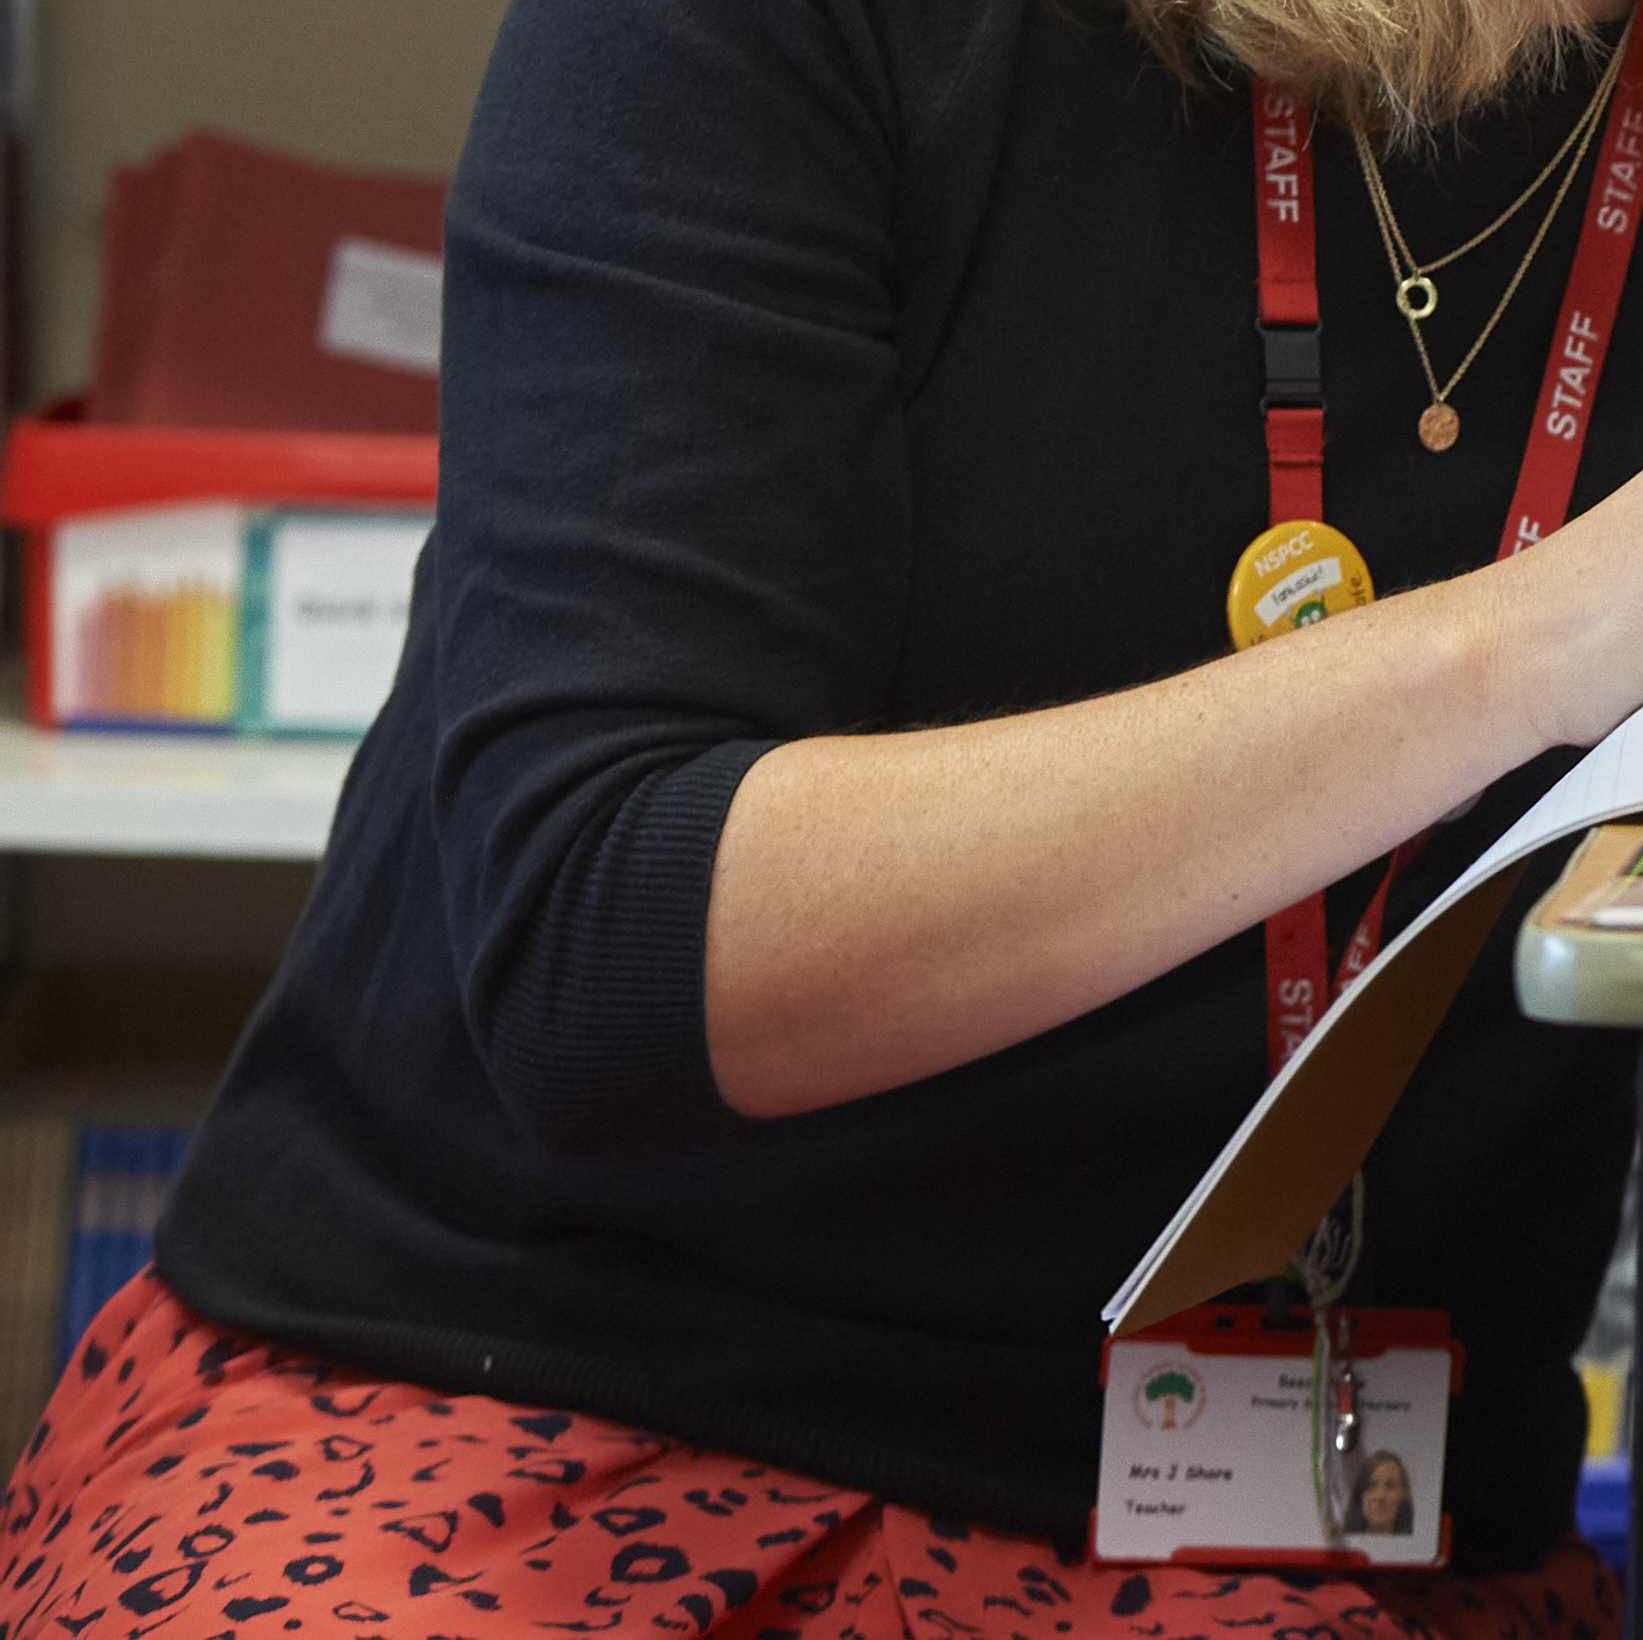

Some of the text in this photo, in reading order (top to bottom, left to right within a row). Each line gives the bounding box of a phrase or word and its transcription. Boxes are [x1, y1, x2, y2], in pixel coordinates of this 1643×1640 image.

[1264, 93, 1299, 223] STAFF
[1546, 310, 1598, 441] STAFF
[1254, 530, 1314, 578] NSPCC
[1277, 978, 1314, 1062] STA
[1124, 1498, 1187, 1515] Teacher
